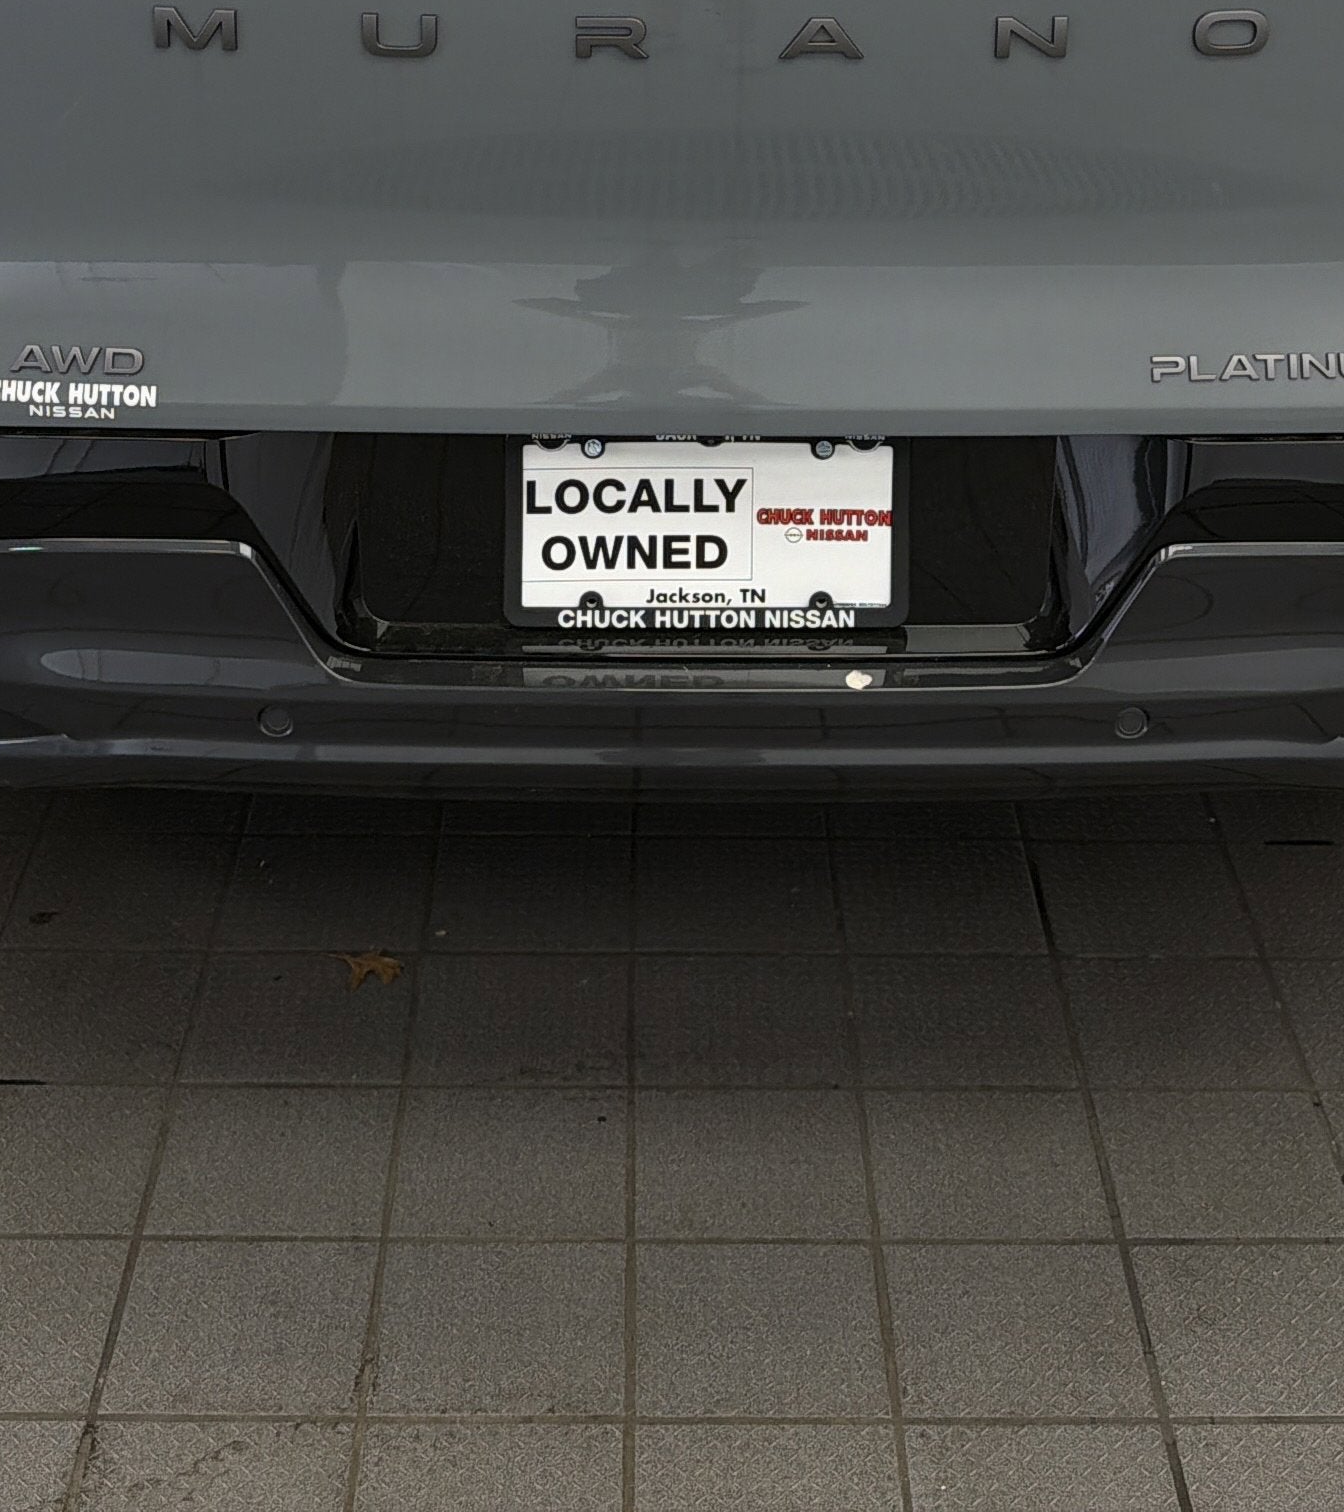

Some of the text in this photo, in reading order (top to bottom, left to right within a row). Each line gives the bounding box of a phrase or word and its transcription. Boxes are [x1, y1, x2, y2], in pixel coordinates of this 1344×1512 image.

[152, 5, 1272, 61] MURANO
[10, 344, 144, 376] AWD
[68, 383, 157, 407] HUTTON
[29, 404, 115, 419] NISSAN
[525, 479, 747, 514] LOCALLY
[756, 509, 892, 526] CHUCK HUTTON
[806, 529, 868, 541] NISSAN
[541, 535, 728, 570] OWNED
[645, 588, 766, 605] Jackson, TN
[557, 610, 855, 628] CHUCK HUTTON NISSAN
